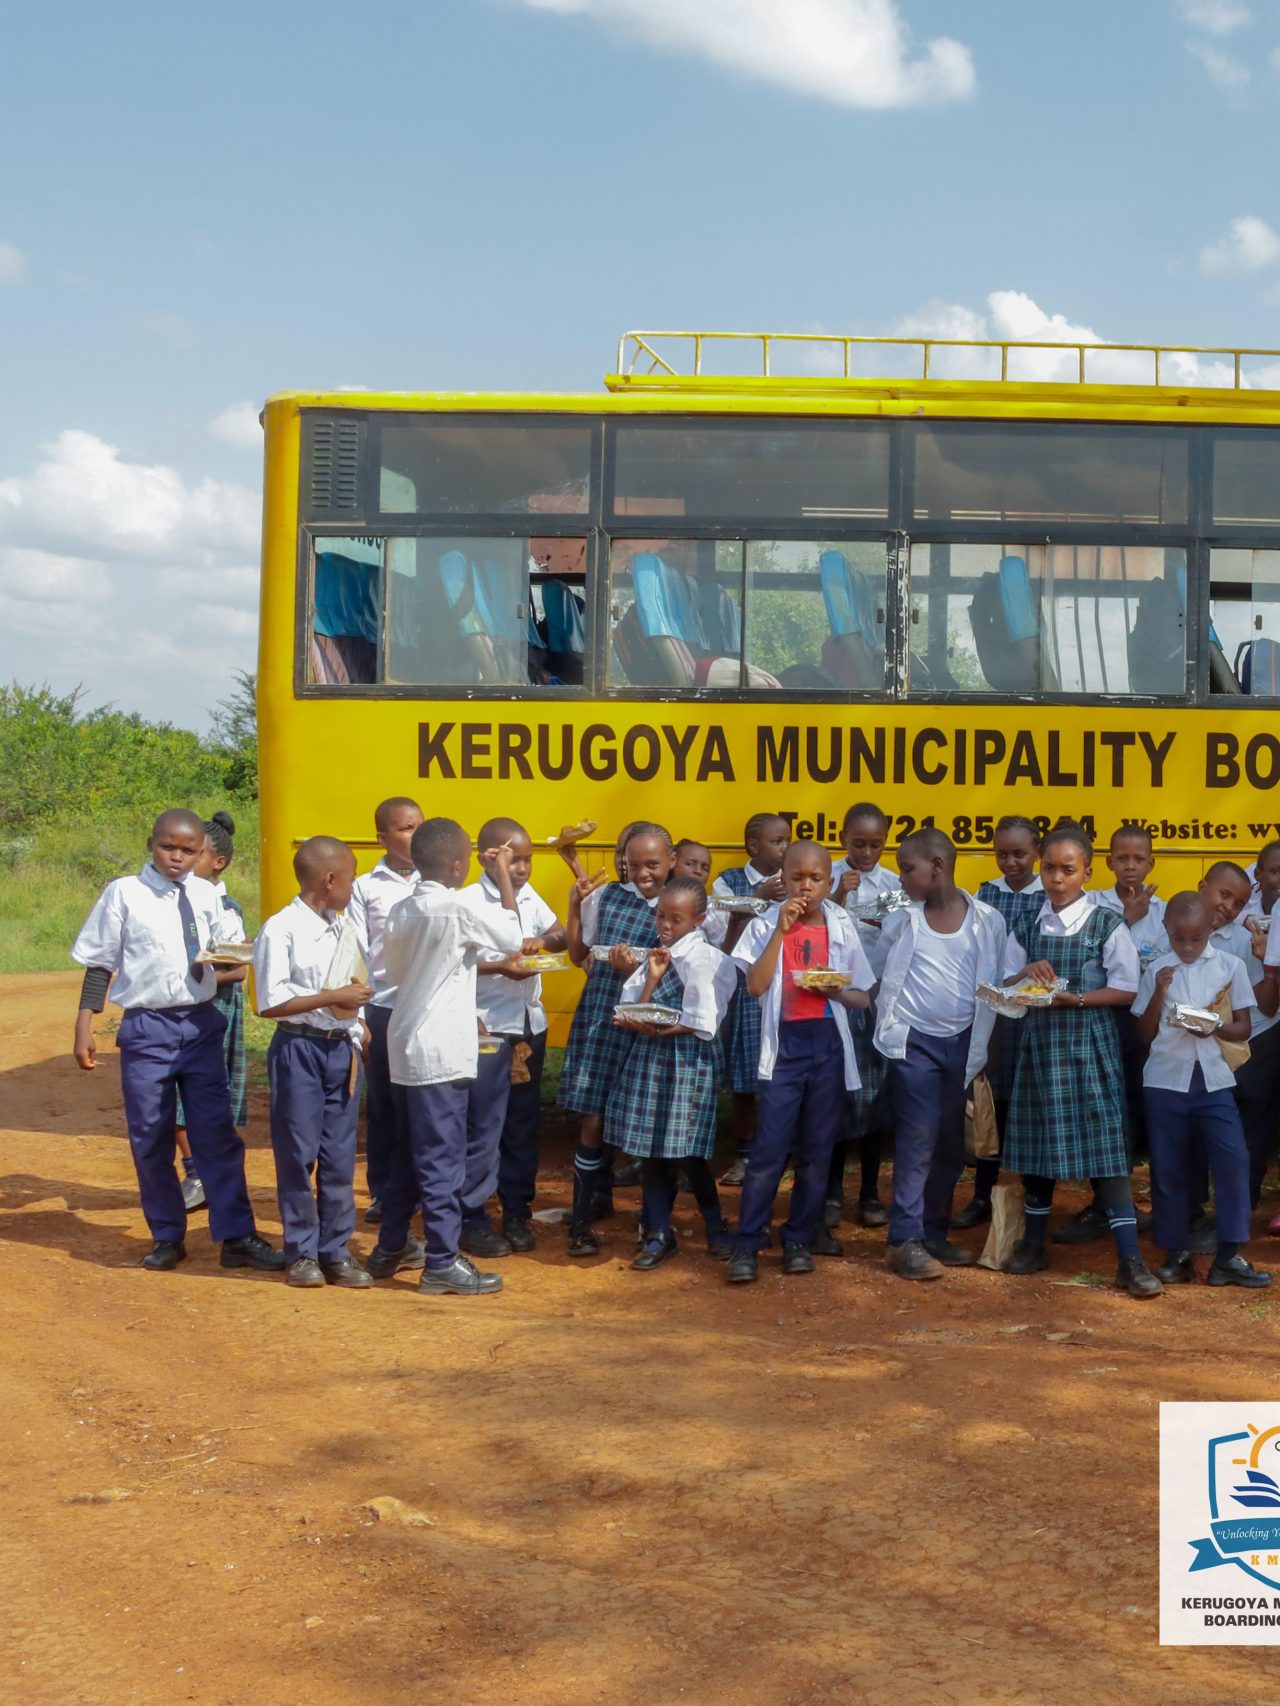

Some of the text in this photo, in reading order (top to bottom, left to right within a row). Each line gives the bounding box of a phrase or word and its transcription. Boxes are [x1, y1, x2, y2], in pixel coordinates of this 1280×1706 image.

[418, 722, 736, 782] KERUGOYA
[756, 725, 1177, 788] MUNICIPALITY
[778, 811, 837, 842] Tel:
